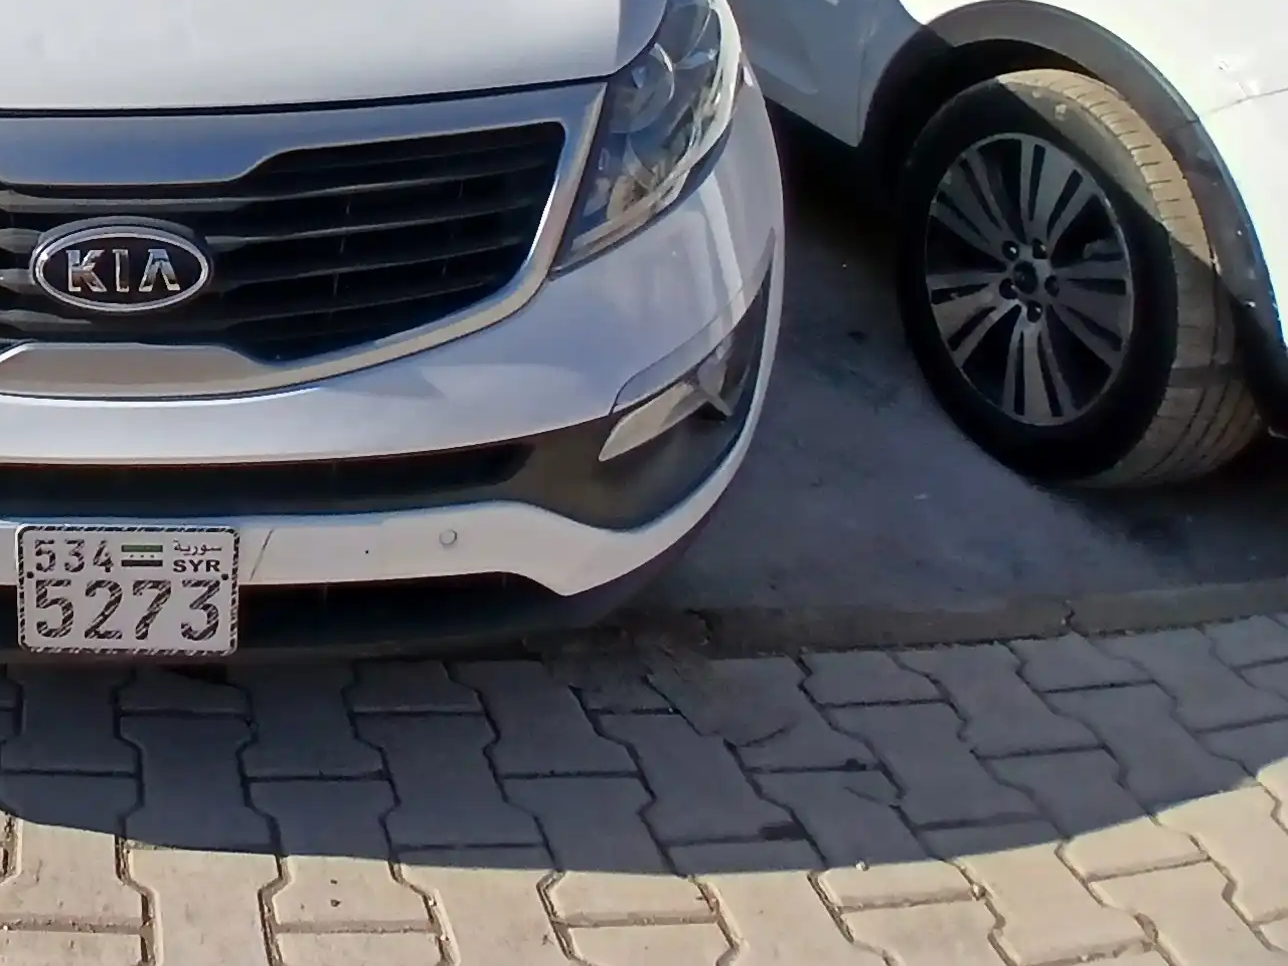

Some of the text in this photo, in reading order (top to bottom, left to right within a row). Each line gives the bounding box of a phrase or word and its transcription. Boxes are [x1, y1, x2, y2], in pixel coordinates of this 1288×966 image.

[65, 248, 181, 293] KIA
[34, 539, 114, 573] 534
[173, 538, 223, 557] سورية
[172, 559, 221, 573] SYR
[35, 579, 221, 641] 5273
